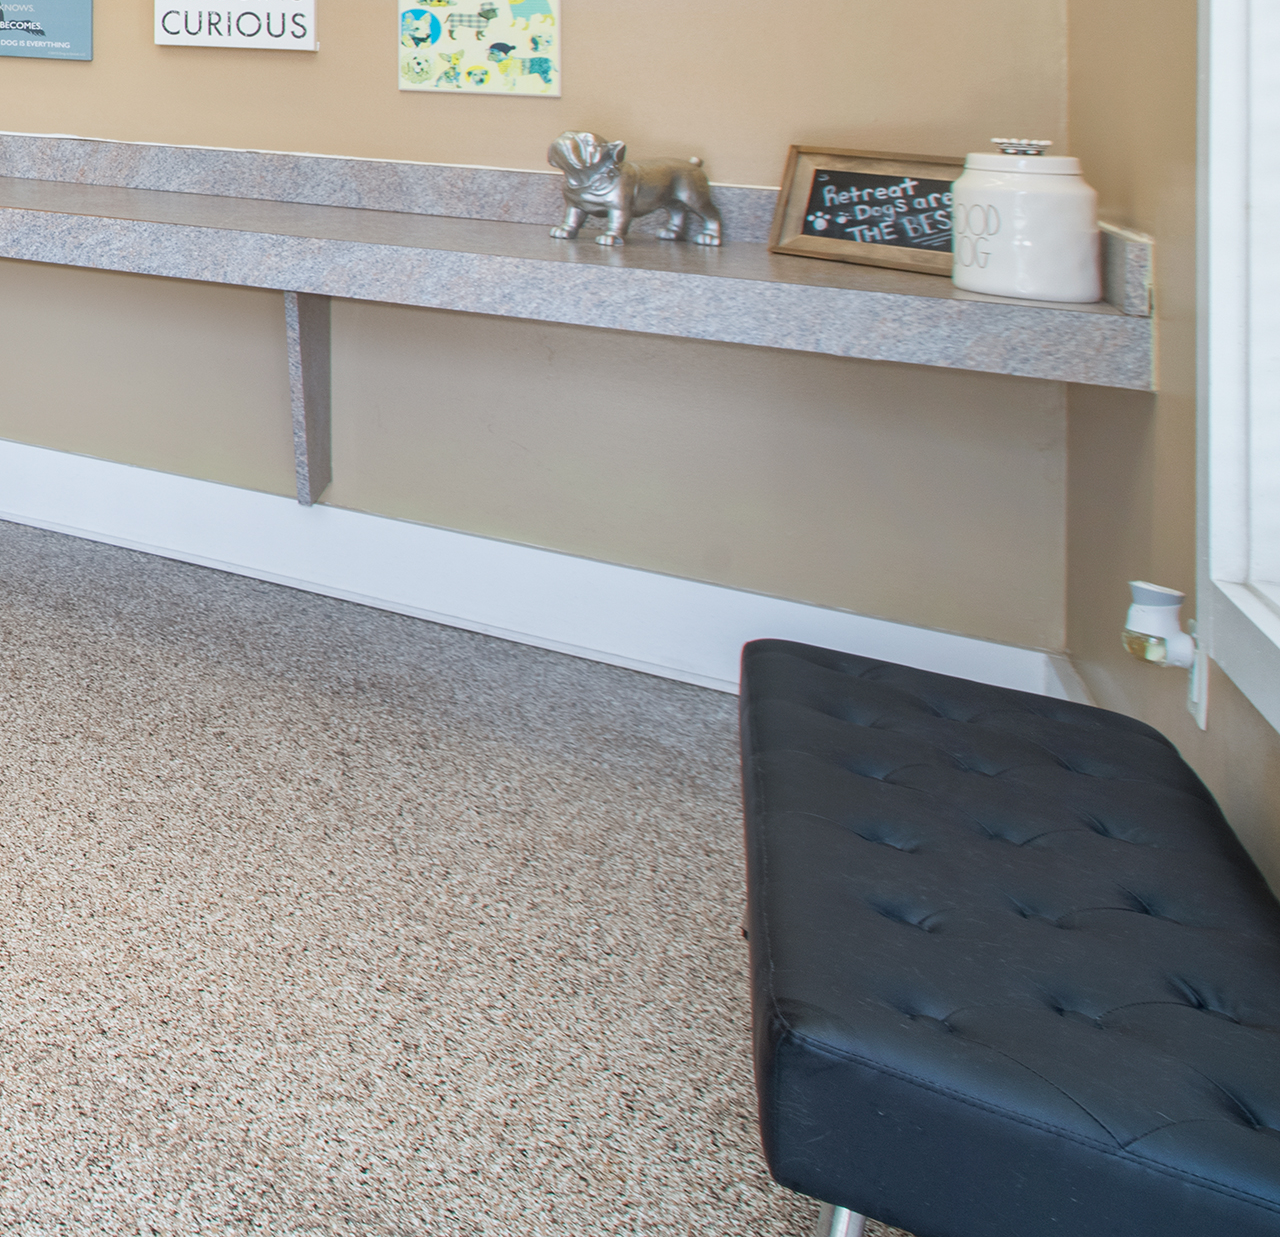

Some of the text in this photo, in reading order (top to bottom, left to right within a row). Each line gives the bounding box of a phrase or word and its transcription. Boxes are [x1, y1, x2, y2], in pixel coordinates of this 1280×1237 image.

[0, 4, 35, 12] KNOWS.
[0, 21, 42, 30] BECOMES.
[162, 10, 307, 39] CURIOUS
[823, 178, 919, 206] Retreat
[854, 192, 953, 221] Dogs are
[845, 208, 953, 242] THE BES
[955, 203, 1000, 236] OOD
[959, 236, 992, 268] OG
